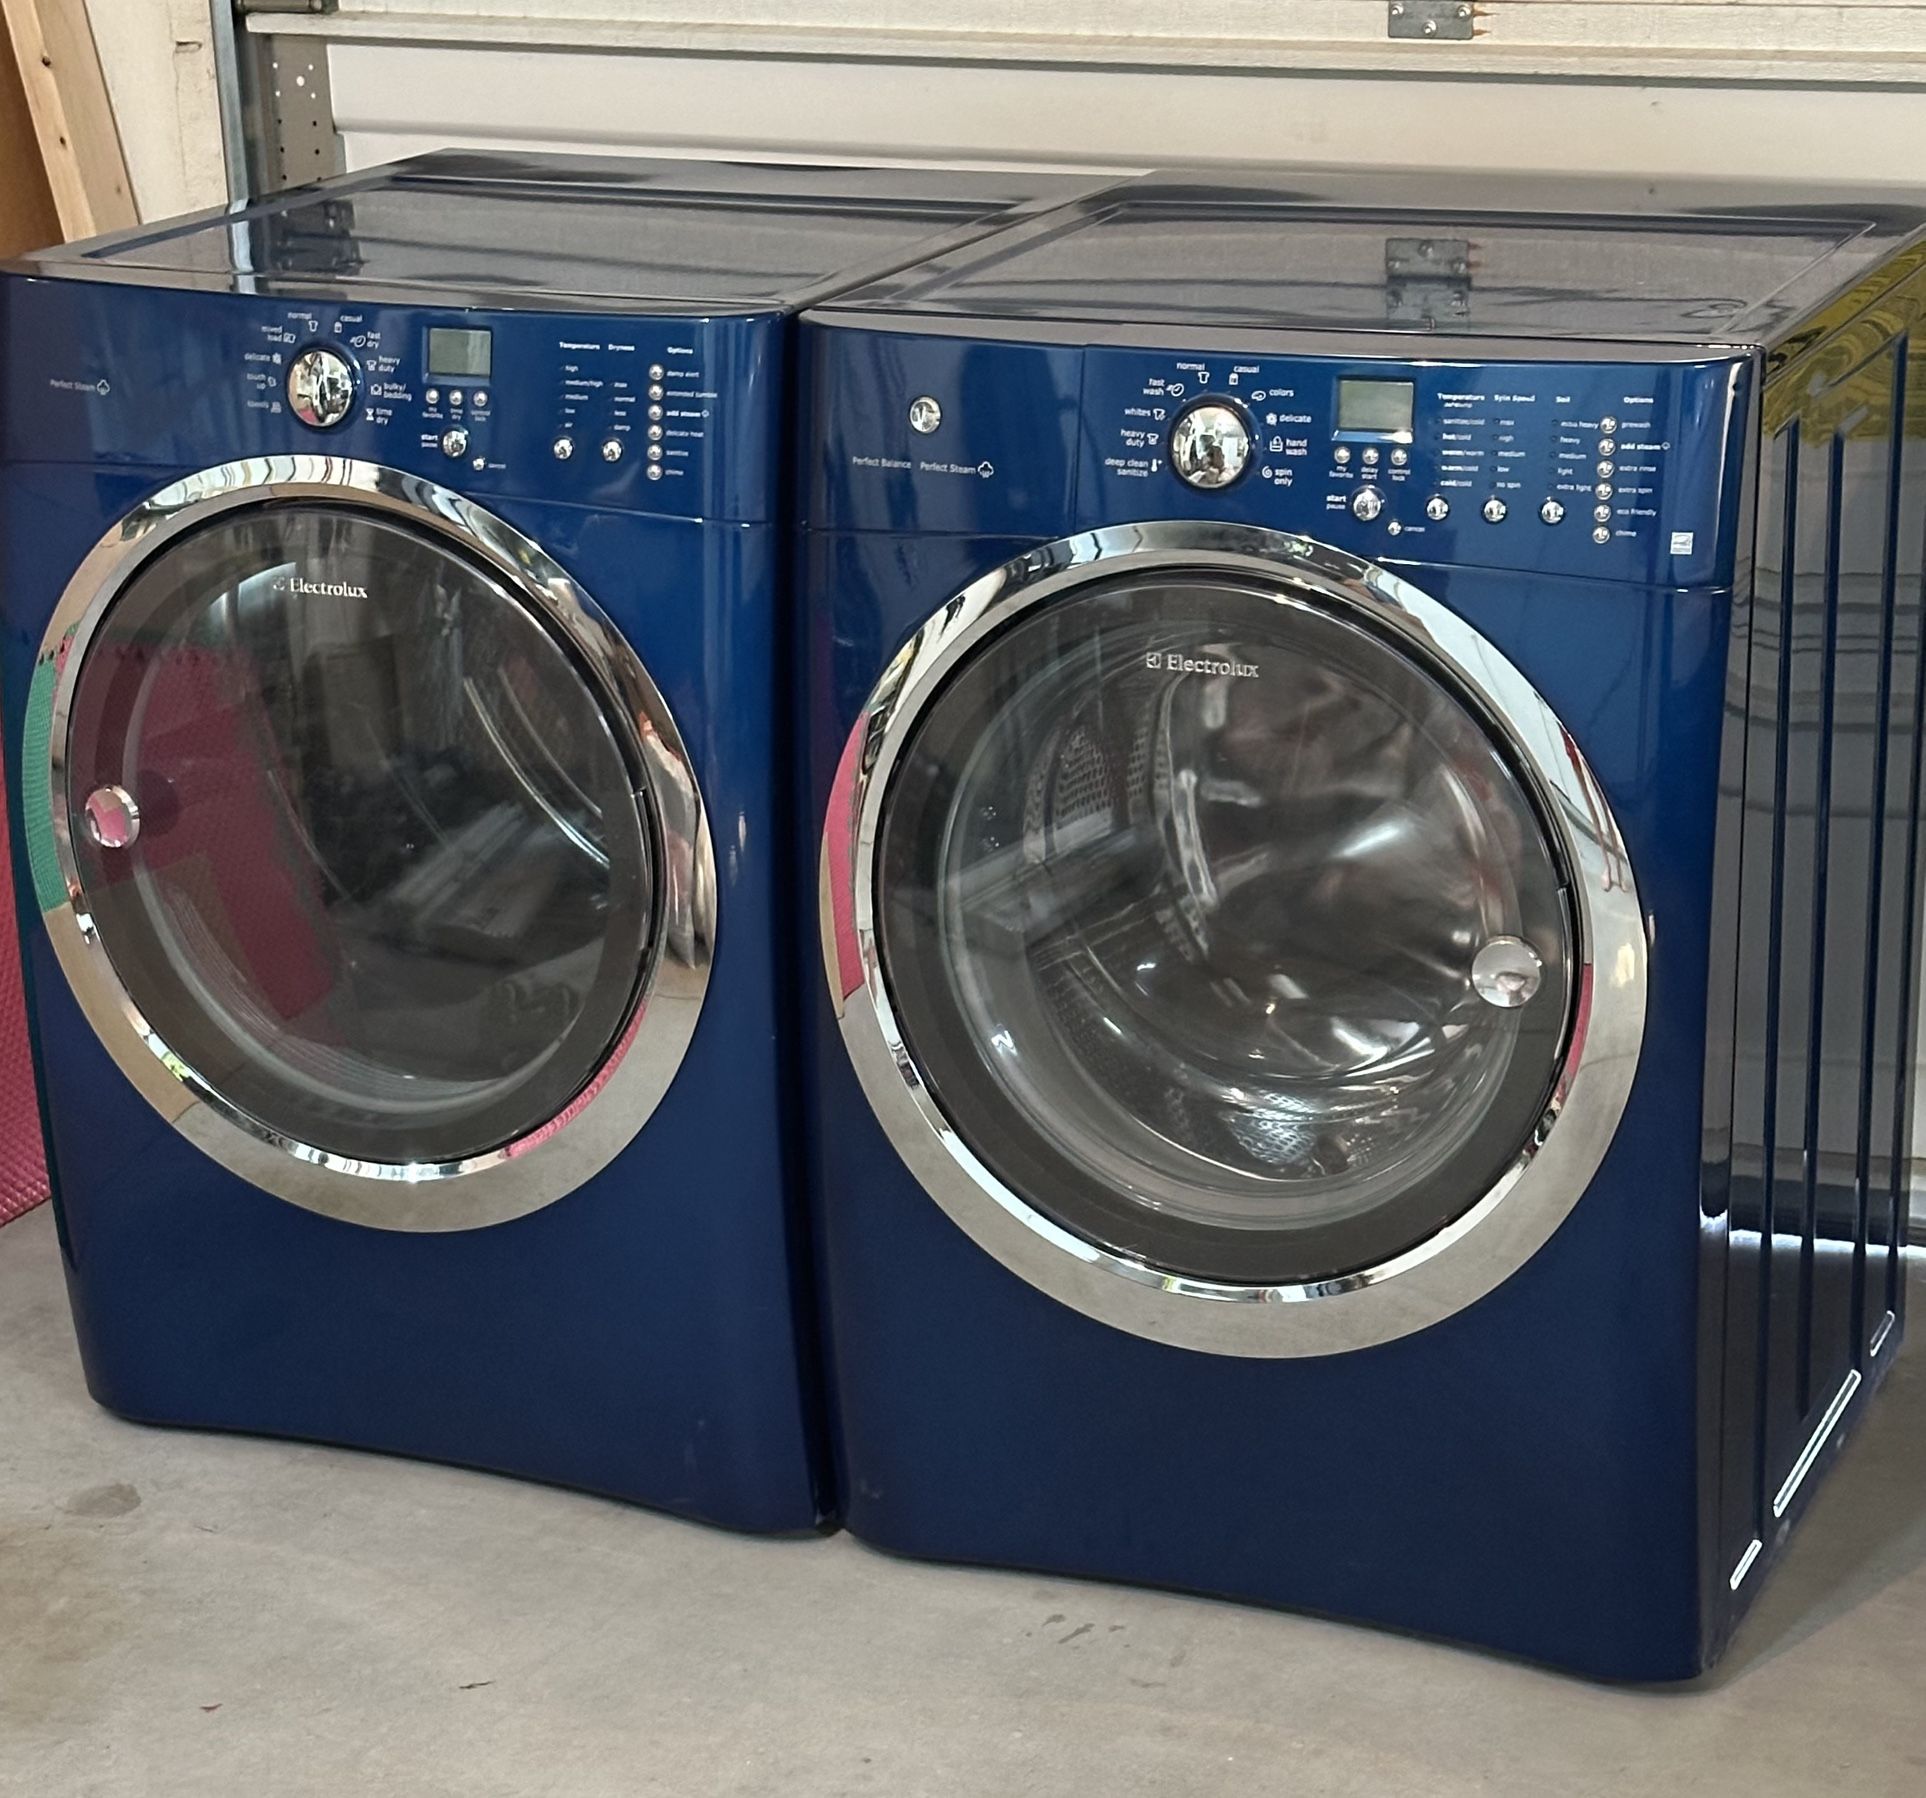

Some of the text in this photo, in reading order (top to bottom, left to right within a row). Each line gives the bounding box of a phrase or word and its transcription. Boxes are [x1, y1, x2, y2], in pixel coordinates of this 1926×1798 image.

[288, 312, 312, 320] normal
[340, 315, 363, 323] casual
[367, 331, 381, 339] fast
[367, 340, 379, 349] dry
[559, 341, 600, 351] Temperature
[379, 356, 400, 366] heavy
[378, 364, 395, 373] duty
[1177, 362, 1205, 371] normal
[1234, 365, 1260, 373] casual
[1149, 378, 1165, 386] fast
[384, 391, 412, 401] bedding
[1143, 387, 1164, 396] wash
[1269, 388, 1294, 397] colors
[1437, 392, 1485, 401] Temperature
[1623, 396, 1654, 404] Options
[375, 408, 392, 416] time
[1124, 408, 1151, 417] whites
[376, 416, 388, 425] dry
[1279, 414, 1311, 423] delicate
[1120, 429, 1145, 439] heavy
[1126, 438, 1144, 448] duty
[1286, 438, 1307, 447] hand
[1286, 447, 1307, 456] wash
[853, 456, 911, 469] Perfect Balance
[1104, 457, 1148, 467] deep clean
[920, 462, 976, 475] Perfect Steam
[1117, 467, 1148, 477] sanitize
[1274, 467, 1293, 477] spin
[1274, 477, 1293, 487] only
[290, 577, 368, 599] Electrolux
[1167, 654, 1260, 678] Electrolux
